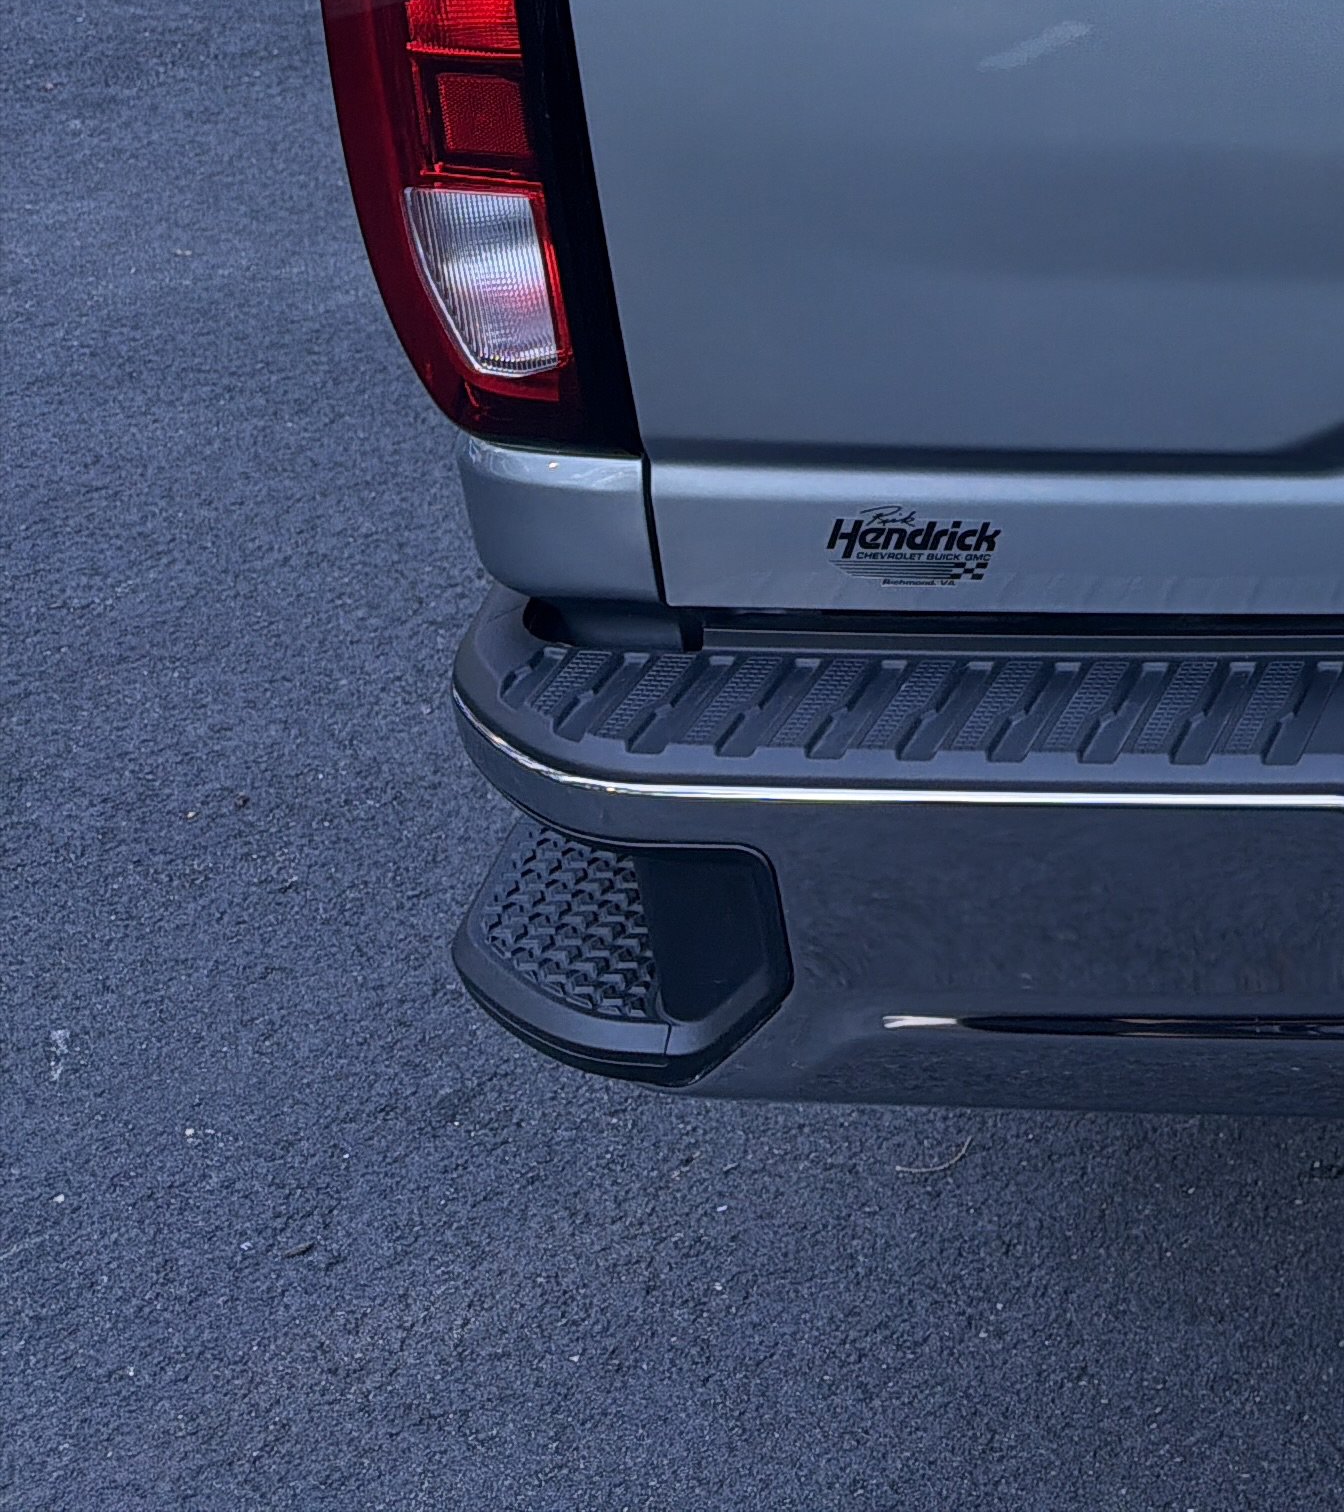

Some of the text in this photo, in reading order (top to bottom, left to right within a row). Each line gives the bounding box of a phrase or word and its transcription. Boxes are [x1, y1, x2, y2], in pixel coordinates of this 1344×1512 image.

[826, 518, 1002, 559] Hendrick
[856, 551, 992, 562] CHEVROLET BUICK GMC
